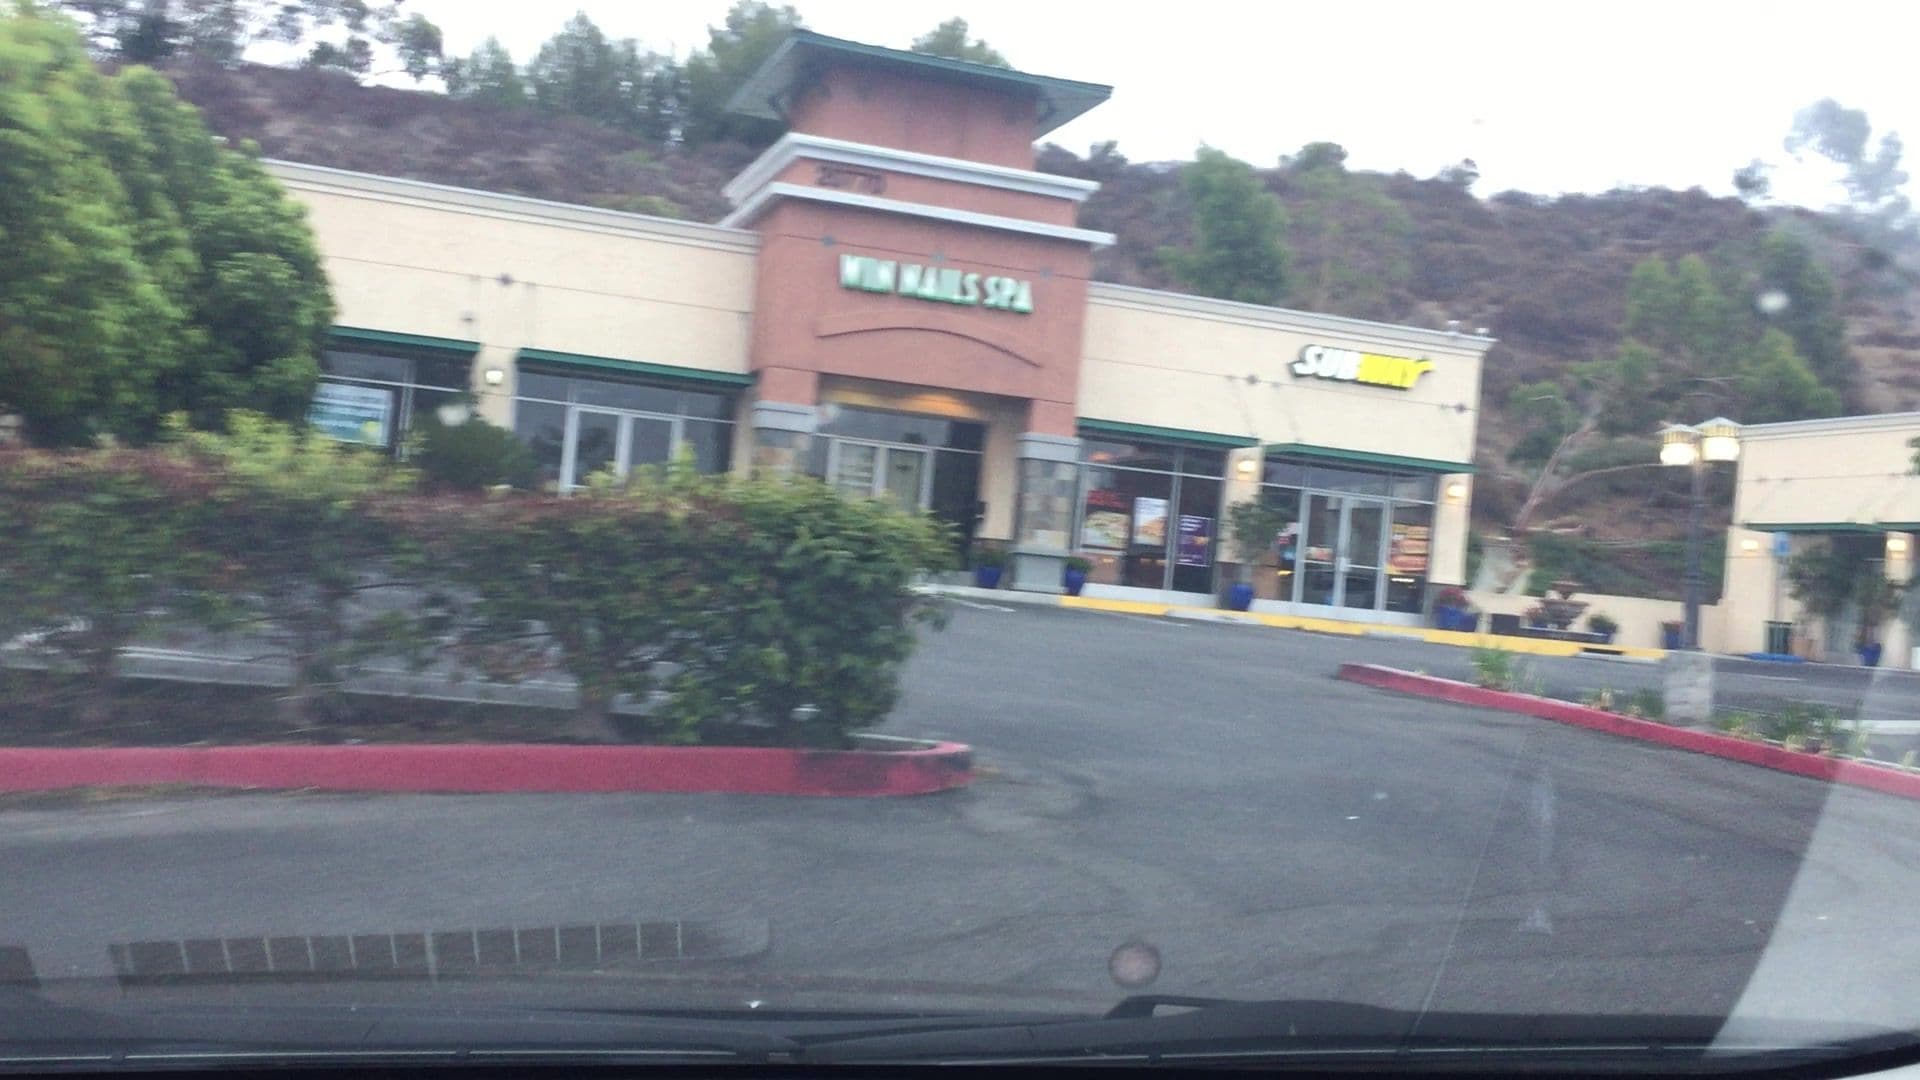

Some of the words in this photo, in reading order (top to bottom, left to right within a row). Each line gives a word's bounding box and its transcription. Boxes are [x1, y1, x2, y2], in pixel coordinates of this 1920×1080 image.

[897, 263, 981, 305] NAILS
[982, 275, 1034, 314] SPA
[1288, 344, 1435, 391] SUBWAY
